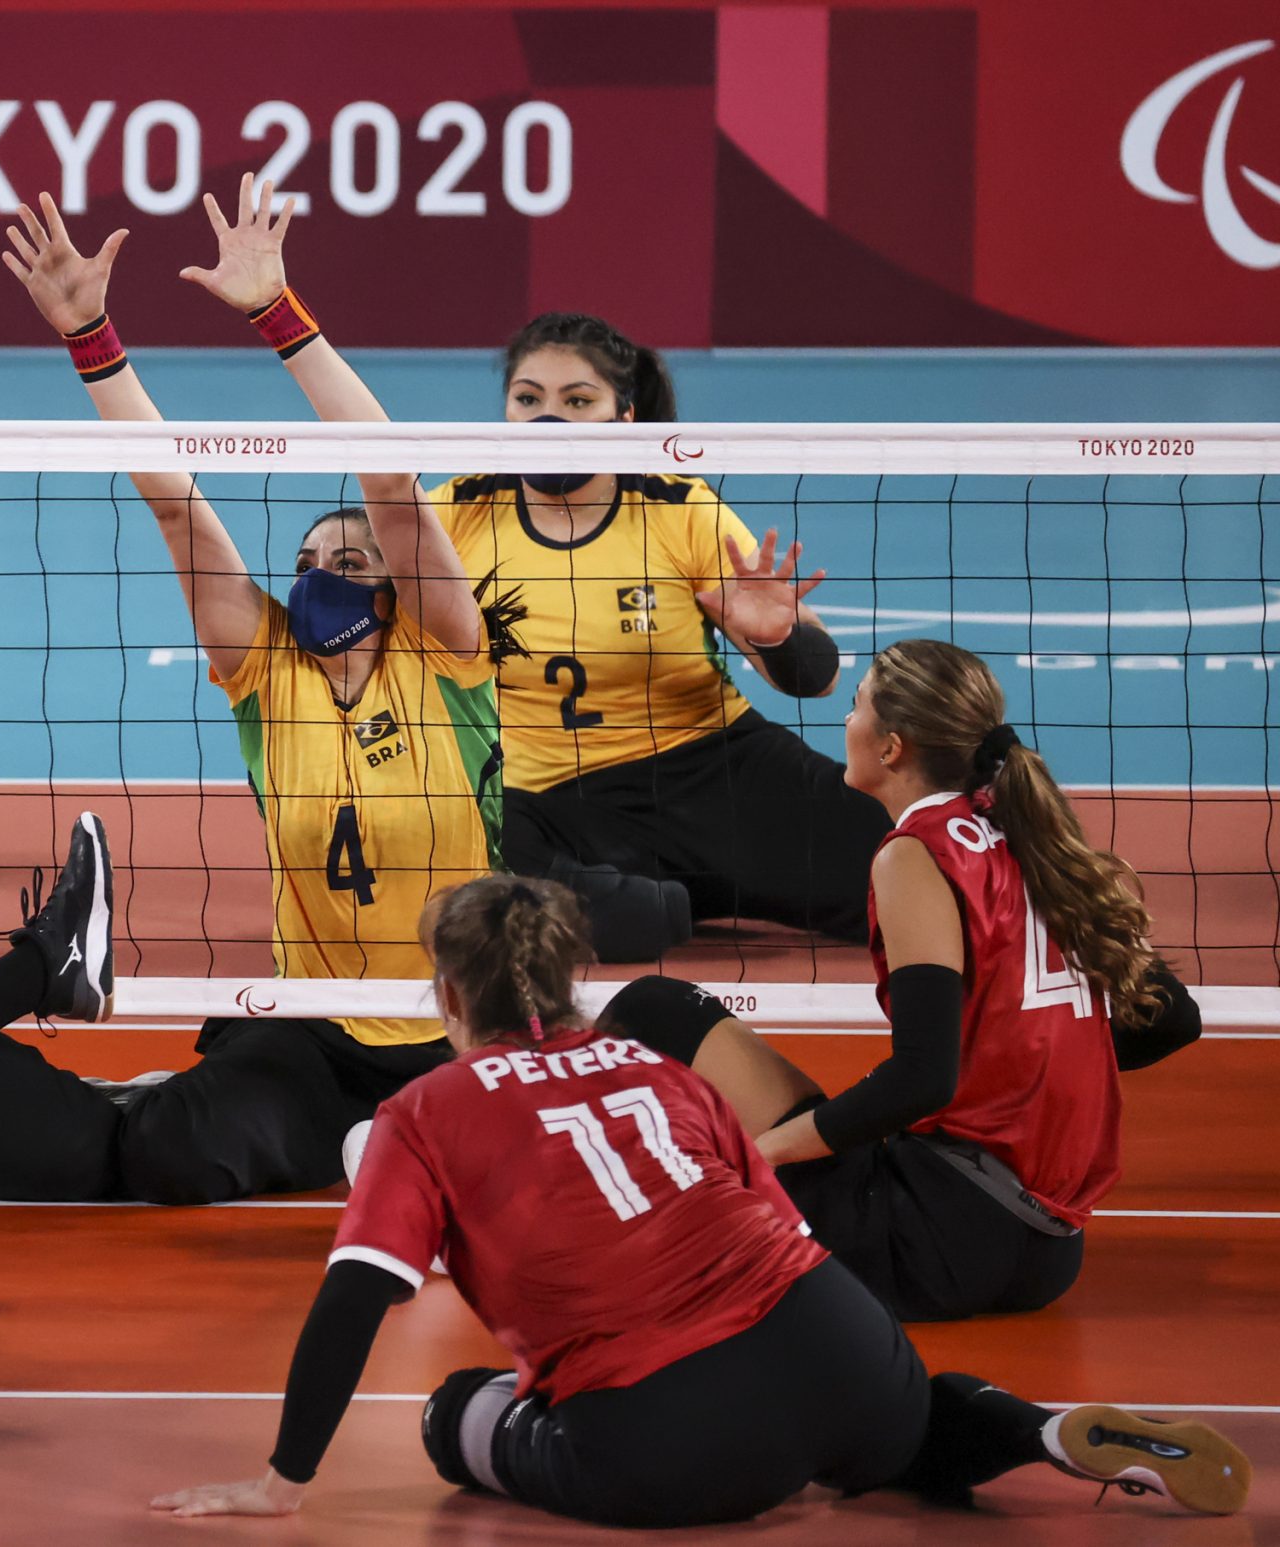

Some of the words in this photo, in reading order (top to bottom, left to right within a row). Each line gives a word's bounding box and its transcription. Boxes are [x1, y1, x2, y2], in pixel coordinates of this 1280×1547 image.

[241, 100, 572, 217] 2020
[174, 437, 236, 454] TOKYO
[241, 438, 287, 454] 2020
[1078, 439, 1142, 456] TOKYO
[1147, 440, 1194, 456] 2020
[323, 630, 351, 649] TOKYO
[350, 617, 370, 634] 2020
[621, 618, 658, 634] BRA
[544, 655, 604, 731] 2
[366, 740, 409, 769] BRA
[326, 805, 376, 907] 4
[712, 995, 757, 1012] 020
